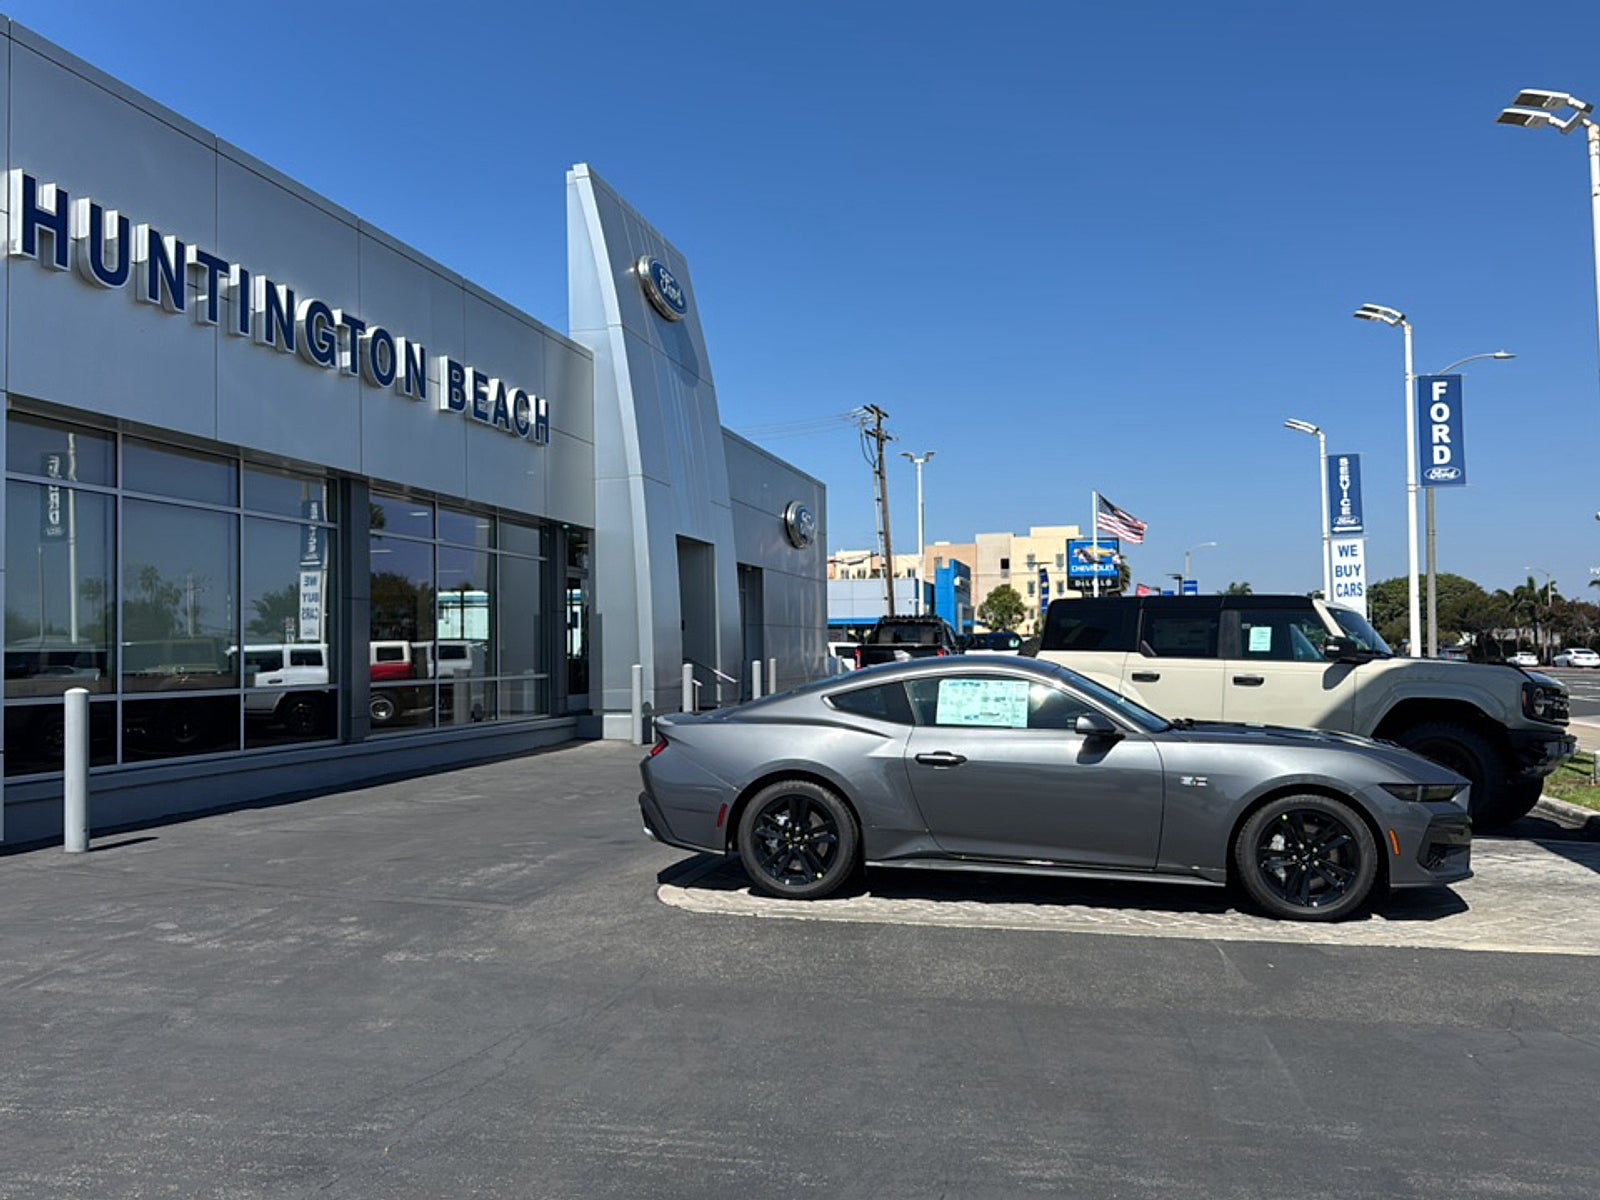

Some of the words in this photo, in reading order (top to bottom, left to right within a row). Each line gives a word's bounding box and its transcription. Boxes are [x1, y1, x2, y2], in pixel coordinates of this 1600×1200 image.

[658, 265, 684, 308] Ford
[9, 168, 428, 402] HUNTINGTON
[438, 355, 551, 446] BEACH
[1430, 381, 1452, 465] FORD
[1338, 456, 1352, 516] SERVICE
[1427, 467, 1458, 480] Ford
[1337, 544, 1359, 558] WE
[1335, 564, 1362, 578] BUY
[1336, 582, 1363, 598] CARS
